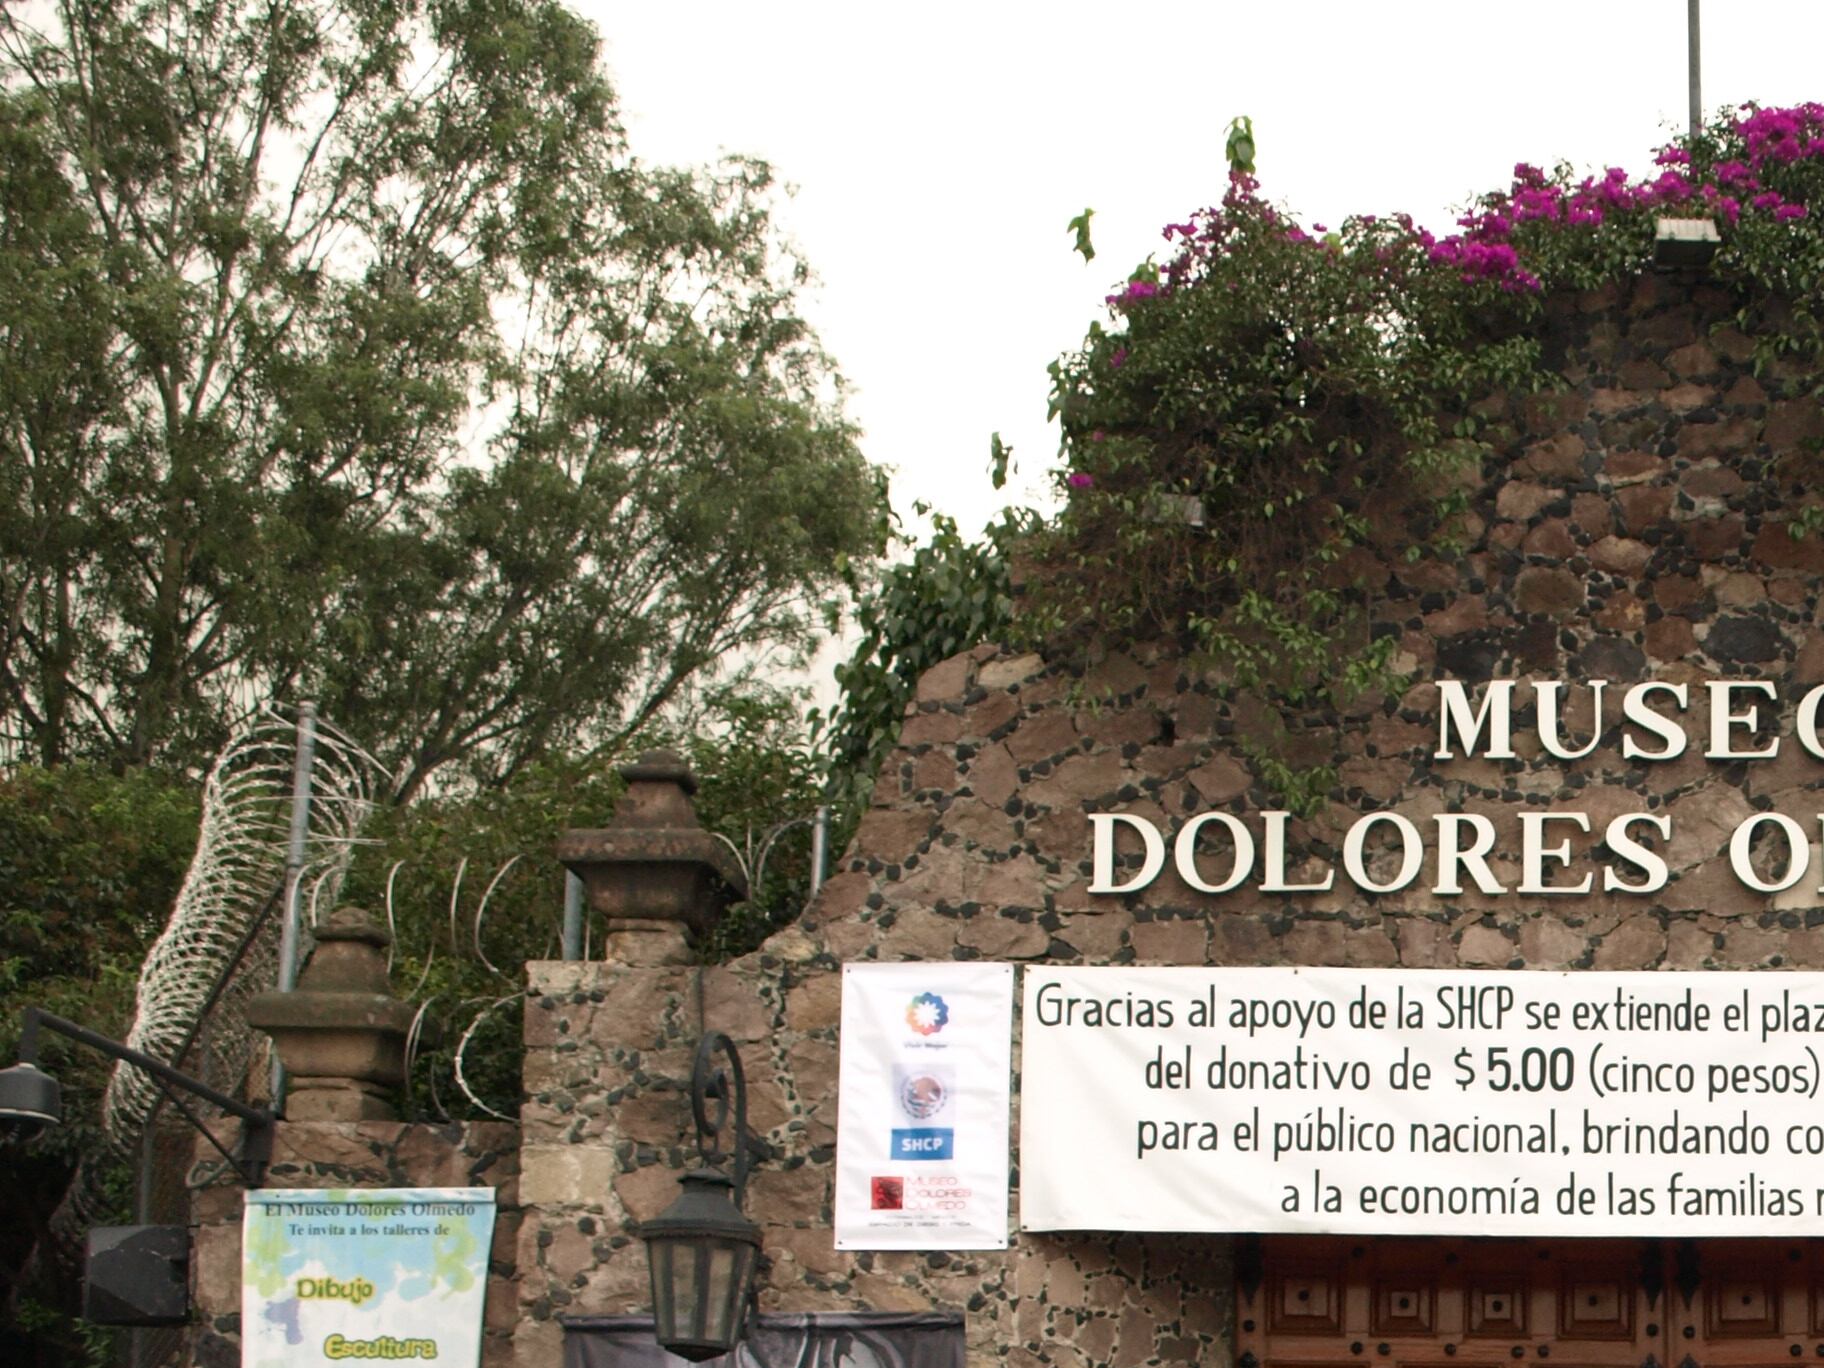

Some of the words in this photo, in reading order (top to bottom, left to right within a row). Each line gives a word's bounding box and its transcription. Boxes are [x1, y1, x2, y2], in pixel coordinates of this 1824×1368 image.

[1087, 811, 1672, 896] DOLORES
[1036, 982, 1174, 1028] Gracias
[1188, 984, 1216, 1028] al
[1228, 999, 1336, 1039] apoyo
[1349, 984, 1387, 1030] de
[1397, 985, 1424, 1030] la
[1436, 985, 1514, 1030] SHCP
[1525, 1001, 1561, 1030] se
[1572, 986, 1710, 1032] extiende
[1723, 988, 1749, 1032] el
[1145, 1044, 1192, 1090] del
[1207, 1044, 1370, 1091] donativo
[1389, 1046, 1431, 1091] de
[1589, 1042, 1695, 1098] (cinco
[1708, 1045, 1820, 1103] pesos)
[901, 1137, 942, 1151] SHCP
[1137, 1120, 1218, 1160] para
[1233, 1106, 1259, 1152] el
[1273, 1106, 1395, 1162] público
[1583, 1108, 1770, 1155] brindando
[265, 1203, 281, 1217] El
[289, 1203, 340, 1217] Museo
[345, 1203, 406, 1217] Dolores
[411, 1202, 476, 1217] Olmedo
[1281, 1185, 1300, 1213] a
[1314, 1169, 1342, 1213] la
[1359, 1177, 1539, 1215] economía
[1556, 1171, 1596, 1216] de
[1608, 1171, 1656, 1216] las
[1667, 1172, 1804, 1217] familias
[289, 1223, 304, 1236] Te
[308, 1223, 345, 1236] invita
[350, 1226, 356, 1236] a
[361, 1222, 379, 1236] los
[383, 1223, 430, 1236] talleres
[434, 1222, 450, 1236] de
[296, 1277, 374, 1307] Dibujo
[324, 1334, 437, 1360] Escultura
